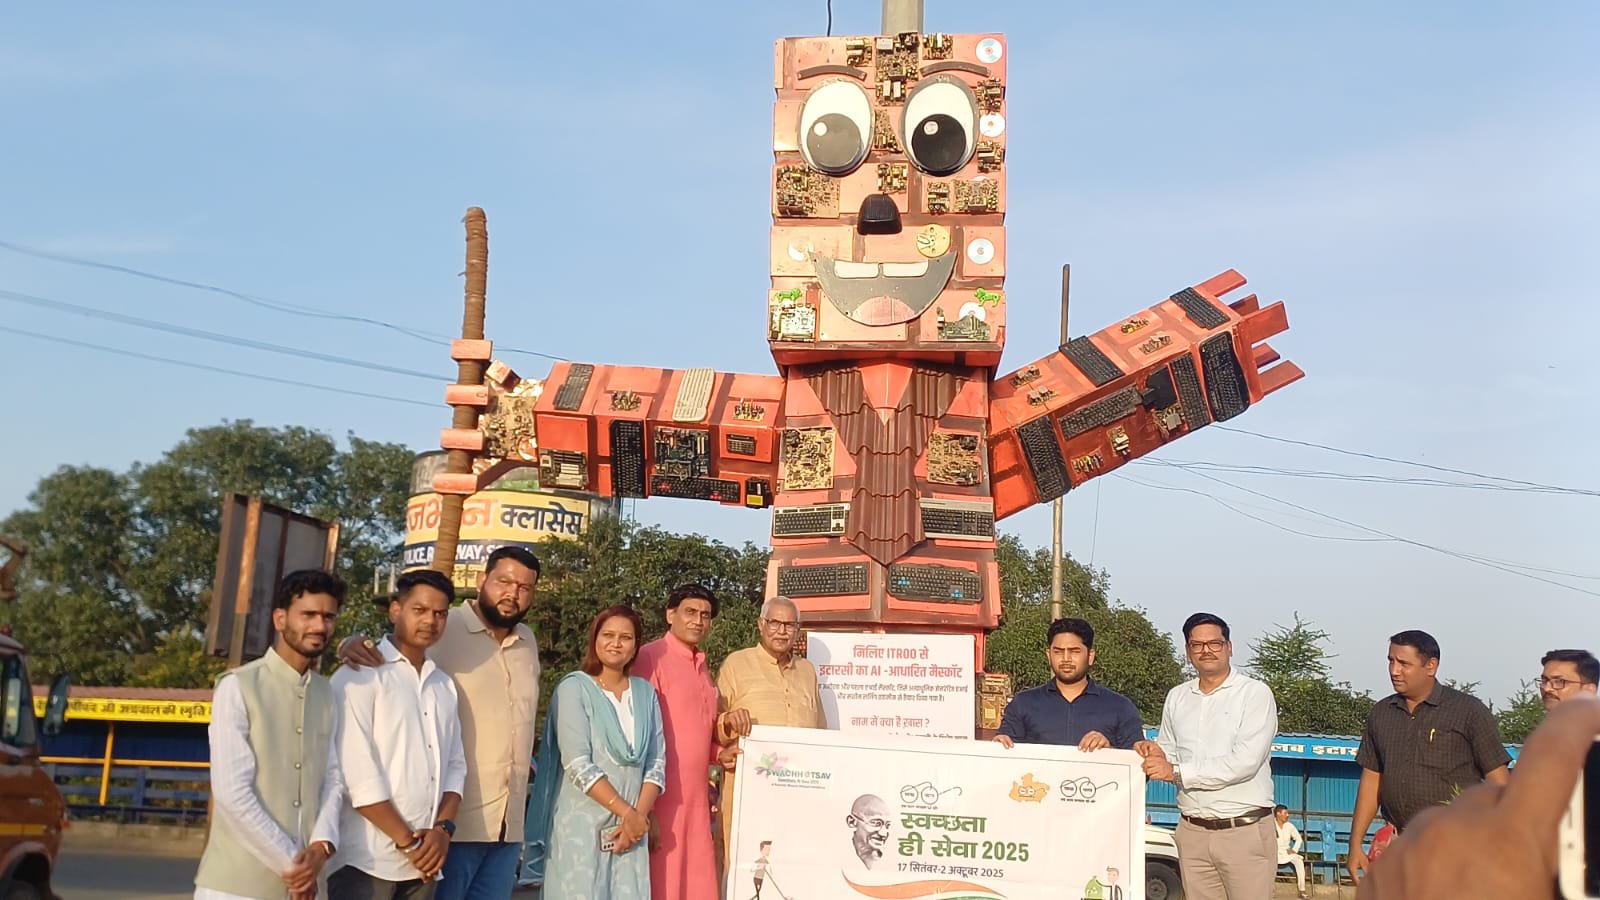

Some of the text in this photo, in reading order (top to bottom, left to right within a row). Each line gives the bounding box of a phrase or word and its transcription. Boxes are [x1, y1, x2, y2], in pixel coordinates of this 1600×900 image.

[501, 502, 583, 536] क्लासेस
[853, 645, 885, 659] मिलिए
[919, 646, 929, 660] से
[818, 663, 853, 677] इटारसी
[856, 665, 869, 677] का
[871, 667, 881, 677] AI
[929, 664, 963, 678] मैस्कॉट
[851, 717, 868, 727] नाम
[870, 715, 879, 728] में
[880, 717, 894, 728] क्या
[896, 715, 901, 728] है
[900, 812, 987, 833] स्वच्छता
[898, 832, 1029, 862] ही सेवा 2025
[898, 862, 907, 872] 17
[981, 868, 1004, 878] 2025
